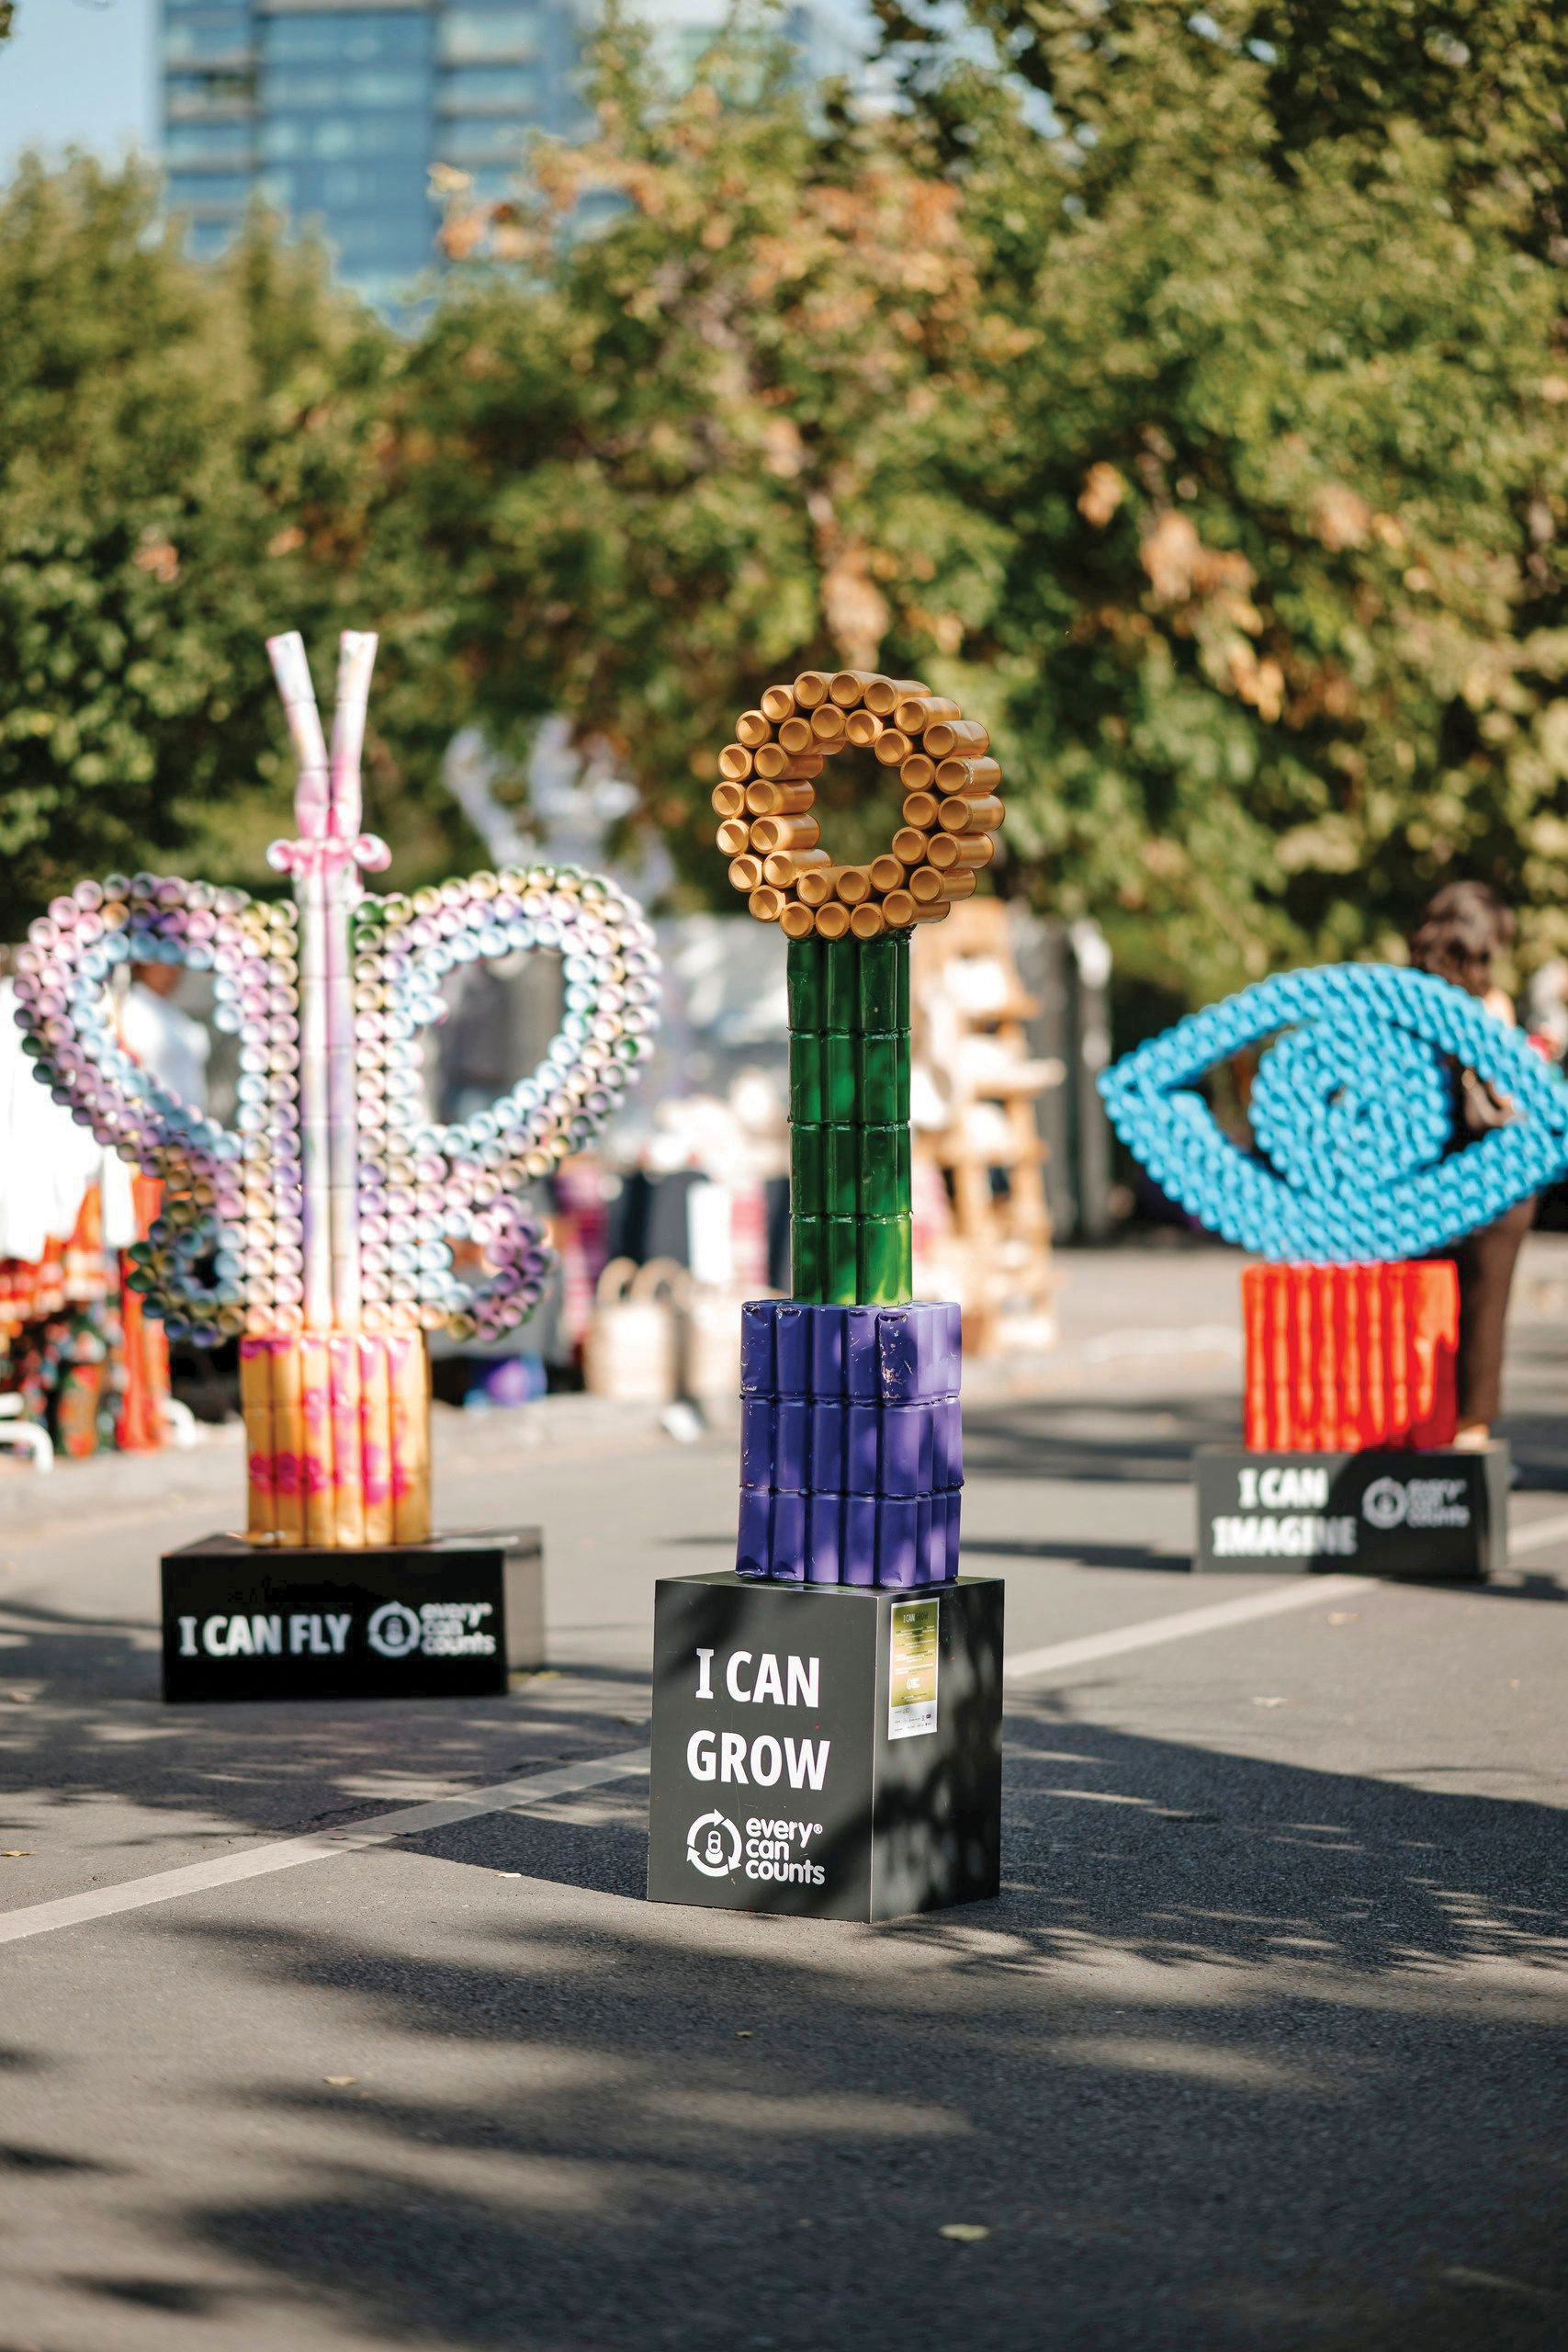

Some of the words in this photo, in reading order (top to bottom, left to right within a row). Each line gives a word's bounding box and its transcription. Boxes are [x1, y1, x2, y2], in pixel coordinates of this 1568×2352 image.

[1238, 1468, 1258, 1509] I
[1258, 1467, 1329, 1509] CAN
[179, 1616, 198, 1656] I
[203, 1613, 282, 1657] CAN
[289, 1613, 353, 1656] FLY
[695, 1647, 714, 1700] I
[726, 1650, 820, 1709] CAN
[687, 1729, 831, 1791] GROW
[746, 1838, 790, 1861] can
[745, 1859, 826, 1885] counts
